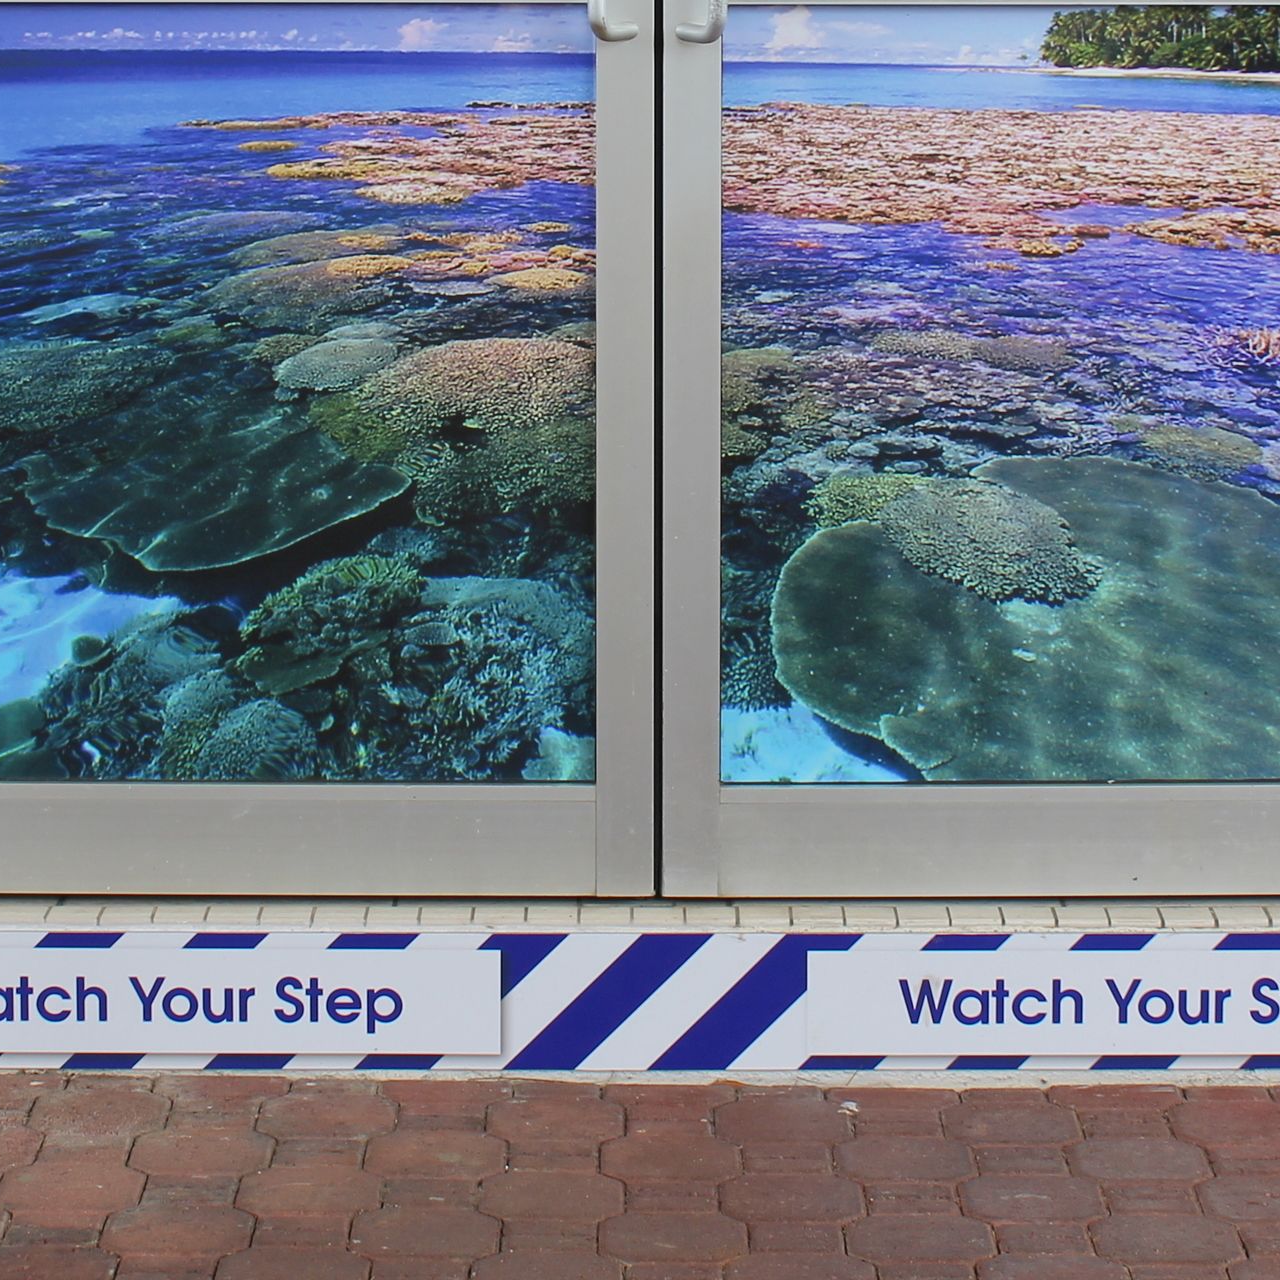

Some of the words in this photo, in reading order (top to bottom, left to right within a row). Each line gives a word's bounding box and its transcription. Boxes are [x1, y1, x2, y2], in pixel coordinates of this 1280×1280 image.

[129, 976, 256, 1024] Your
[274, 976, 403, 1034] Step
[898, 979, 1084, 1026] Watch
[1105, 978, 1232, 1026] Your
